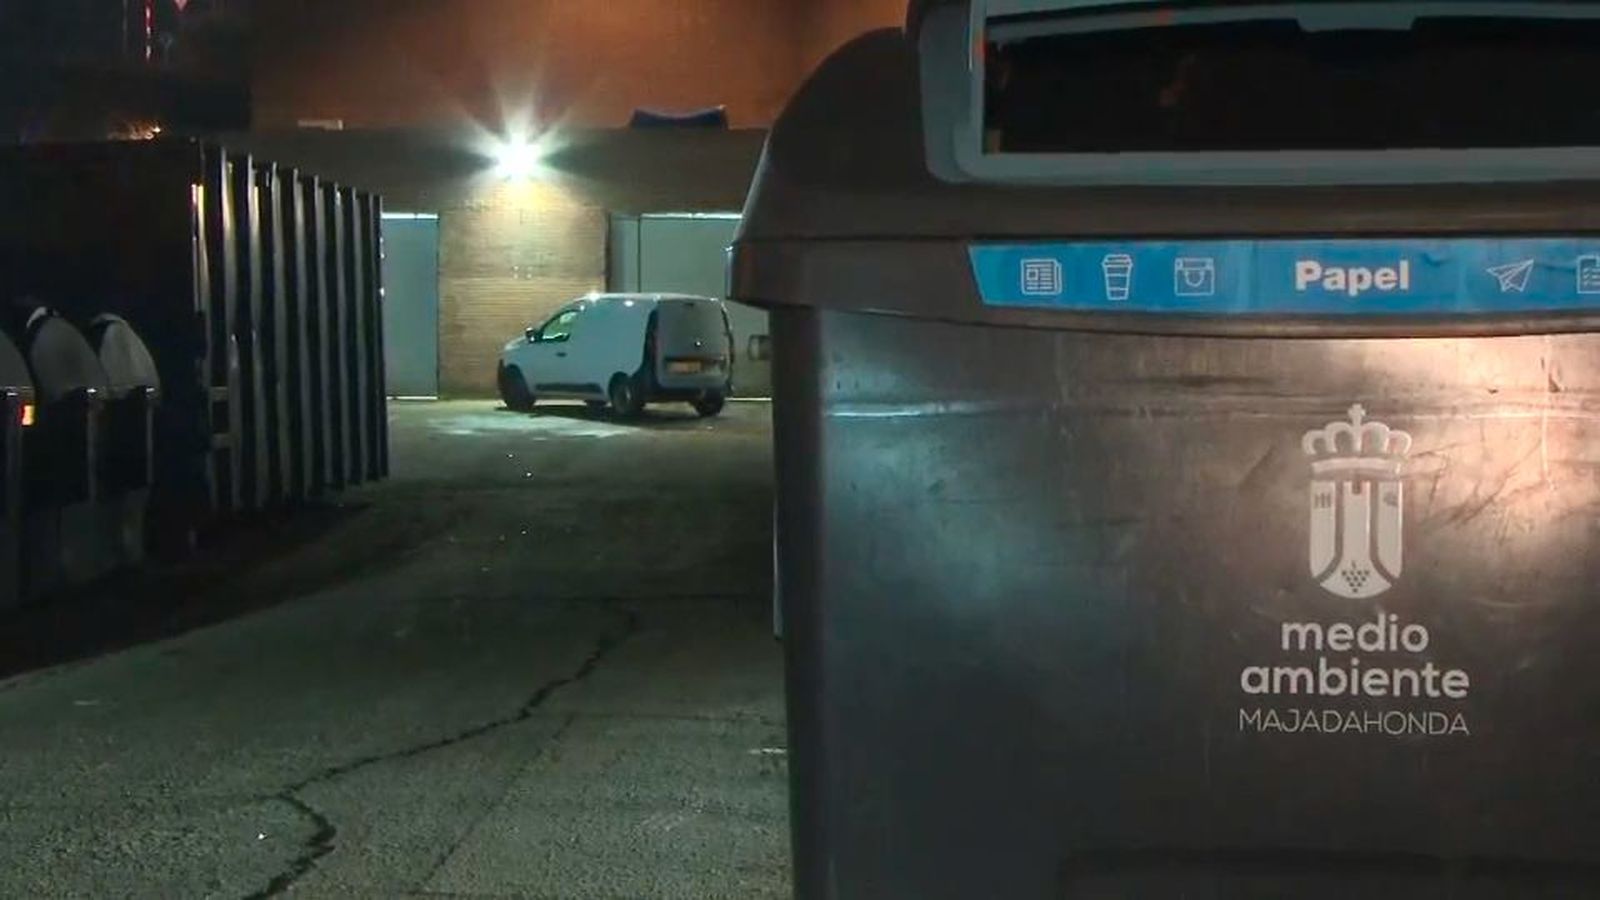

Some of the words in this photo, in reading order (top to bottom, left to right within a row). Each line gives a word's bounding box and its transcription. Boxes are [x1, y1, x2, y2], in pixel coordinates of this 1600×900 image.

[1295, 260, 1409, 296] Papel
[1281, 613, 1429, 652] medio
[1240, 657, 1470, 698] ambiente
[1238, 708, 1470, 736] MAJADAHONDA
